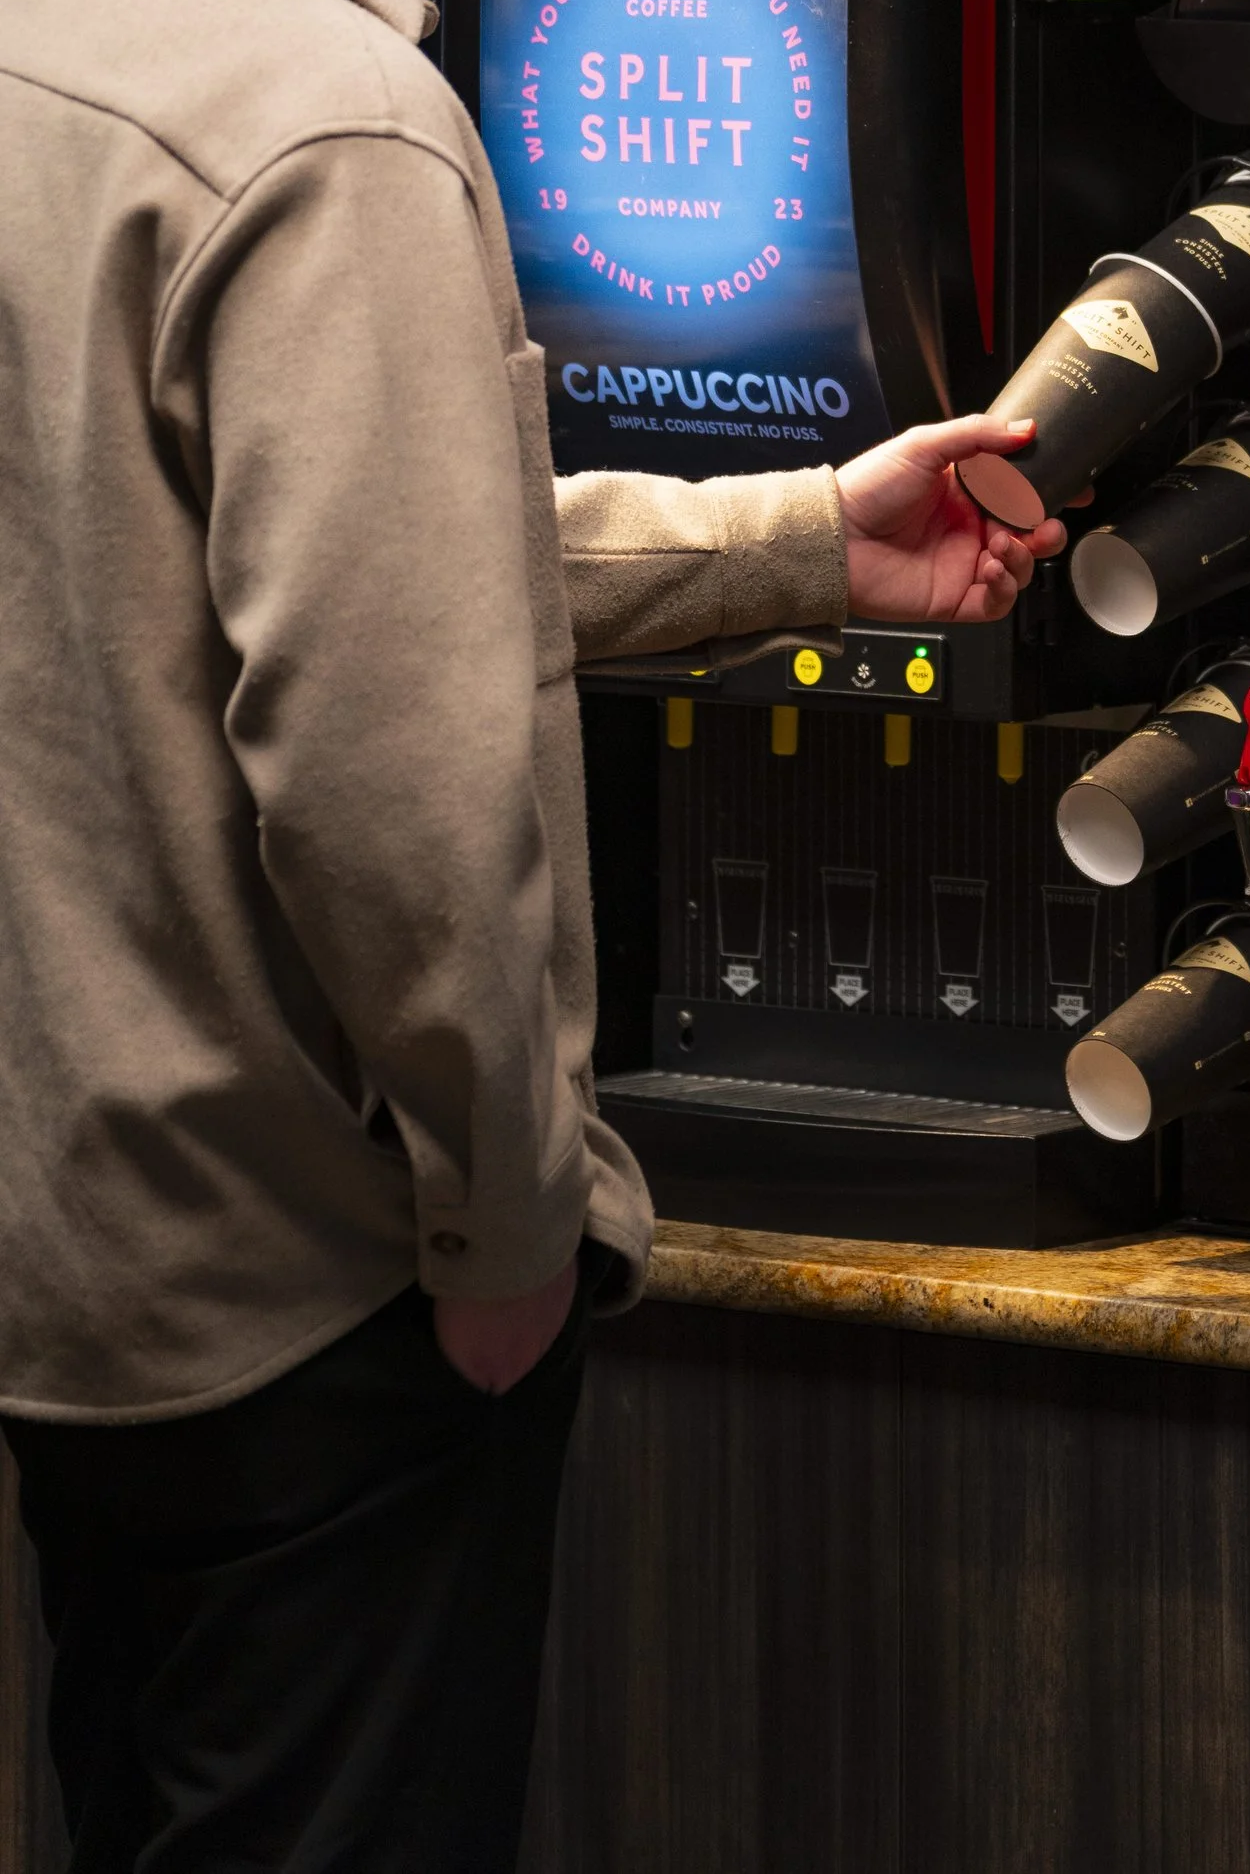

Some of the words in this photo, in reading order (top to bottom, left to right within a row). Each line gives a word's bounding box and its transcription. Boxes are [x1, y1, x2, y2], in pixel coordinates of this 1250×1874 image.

[579, 50, 752, 105] SPLIT
[781, 25, 812, 120] NEED
[521, 60, 545, 164] WHAT
[579, 113, 752, 167] SHIFT
[790, 135, 810, 172] IT
[538, 187, 568, 211] 19
[617, 196, 722, 220] COMPANY
[773, 197, 804, 221] 23
[1175, 238, 1227, 281] CONSISTENT
[1183, 246, 1196, 256] NO
[1195, 253, 1212, 270] FUSS
[1199, 238, 1225, 260] SIMPLE
[571, 232, 654, 301] DRINK
[666, 284, 691, 307] IT
[701, 244, 782, 307] PROUD
[1114, 327, 1151, 360] SHIFT
[1064, 353, 1092, 373] SIMPLE
[1040, 359, 1098, 396] CONSISTENT
[1048, 369, 1061, 378] NO
[1060, 374, 1080, 391] FUSS
[561, 361, 850, 419] CAPPUCCINO
[608, 414, 664, 433] SIMPLE.
[667, 418, 757, 439] CONSISTENT.
[759, 425, 782, 439] NO
[782, 426, 824, 443] FUSS.
[800, 663, 816, 671] PUSH
[1193, 694, 1232, 713] SHIFT
[1207, 949, 1246, 972] SHIFT
[948, 988, 969, 998] PLACE
[951, 999, 968, 1007] HERE
[1060, 998, 1081, 1007] PLACE
[1062, 1009, 1079, 1017] HERE
